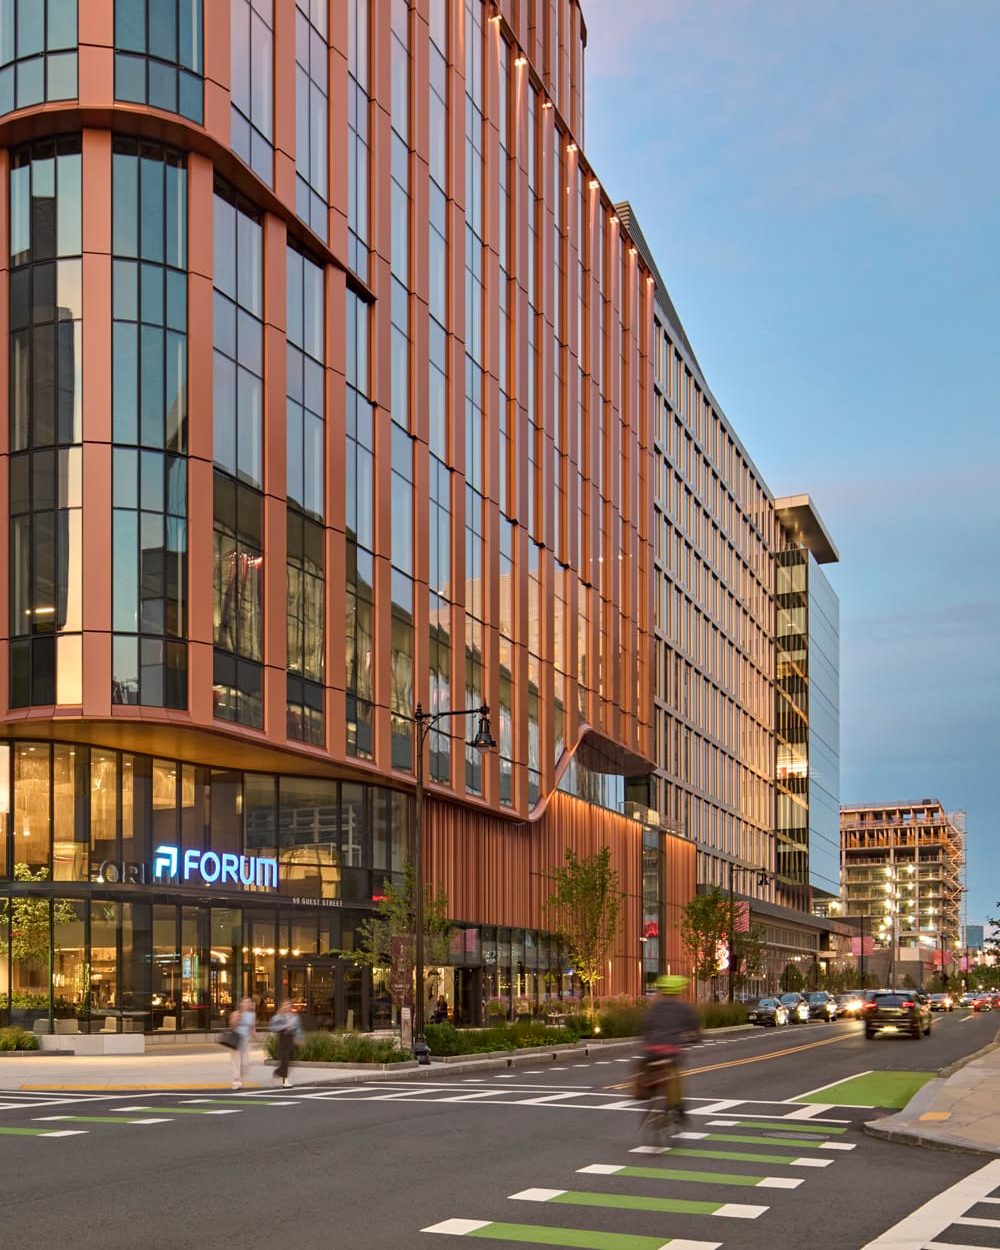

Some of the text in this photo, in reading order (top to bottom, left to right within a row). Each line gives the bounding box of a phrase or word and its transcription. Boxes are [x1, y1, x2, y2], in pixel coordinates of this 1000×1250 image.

[184, 849, 278, 888] FORUM
[301, 898, 320, 906] GUEST
[321, 899, 343, 907] STREET
